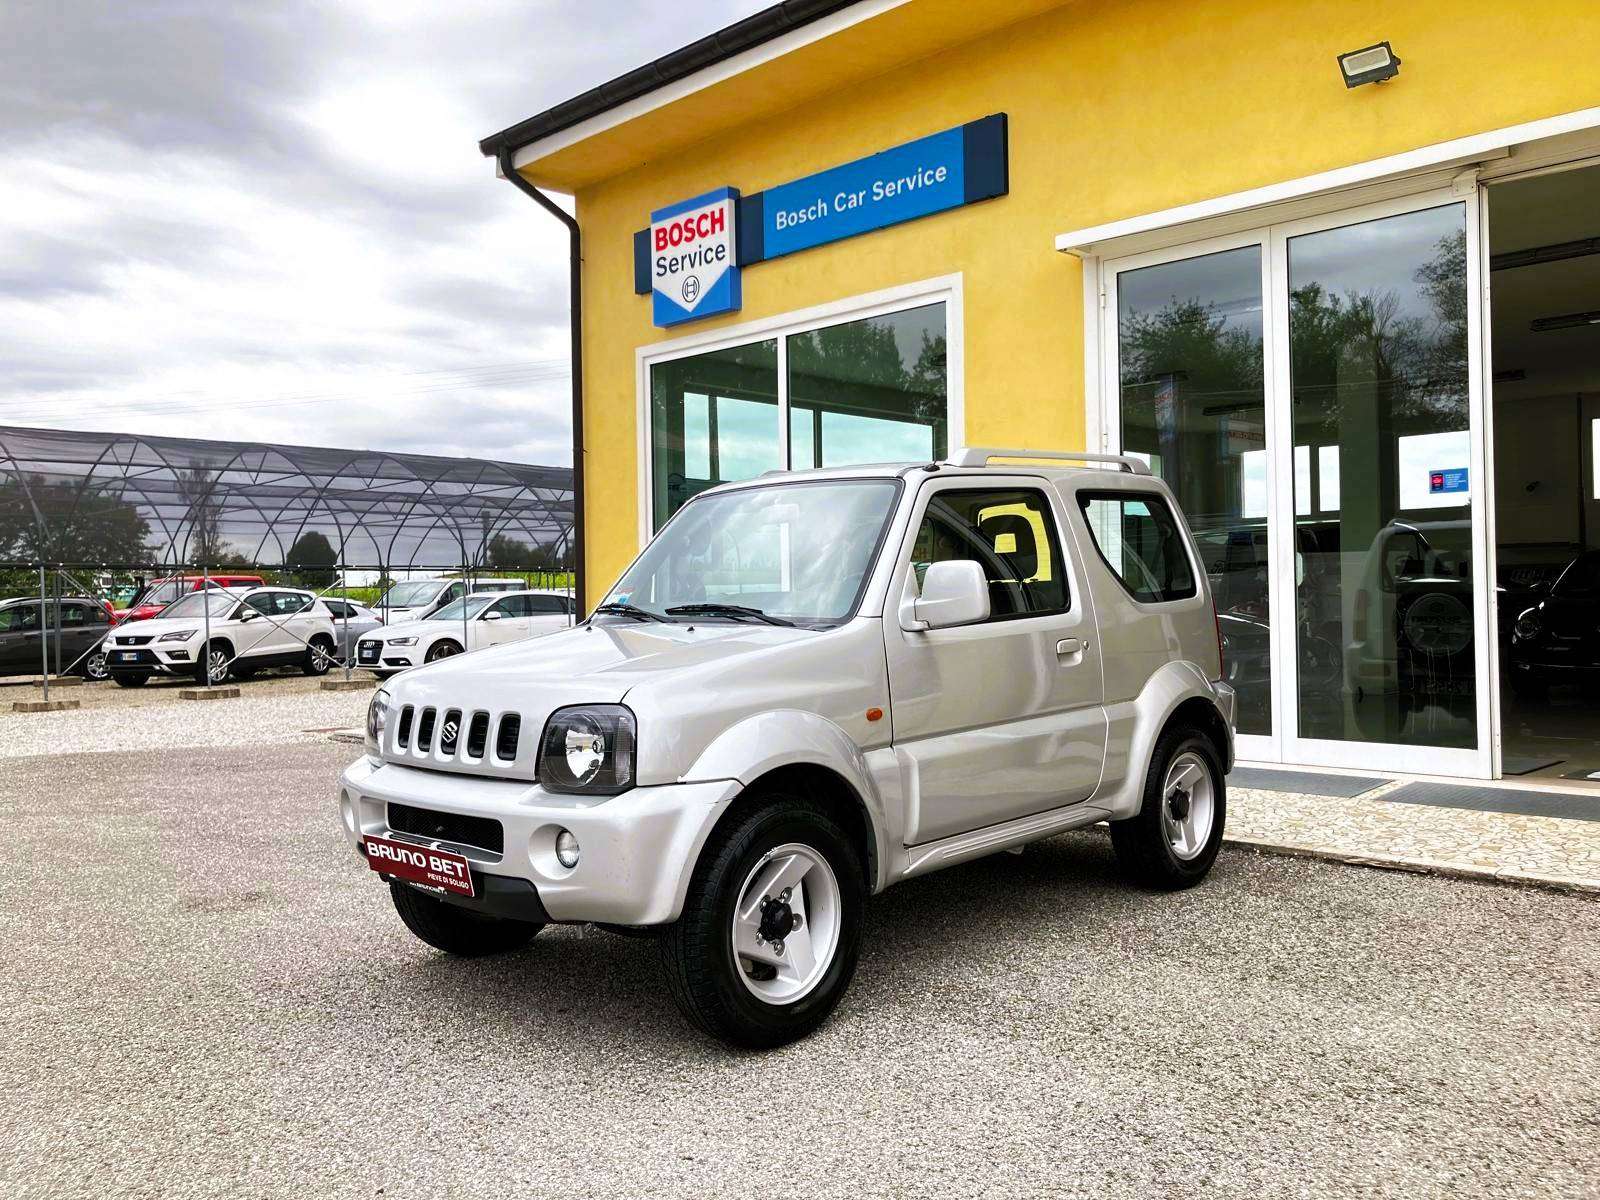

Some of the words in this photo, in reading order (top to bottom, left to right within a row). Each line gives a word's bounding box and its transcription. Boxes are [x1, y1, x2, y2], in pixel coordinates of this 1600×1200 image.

[776, 198, 828, 231] Bosch
[834, 191, 867, 213] Car
[872, 165, 947, 202] Service
[655, 207, 725, 252] BOSCH
[656, 243, 726, 277] Service
[366, 841, 427, 868] BRUNO
[429, 855, 465, 878] BET
